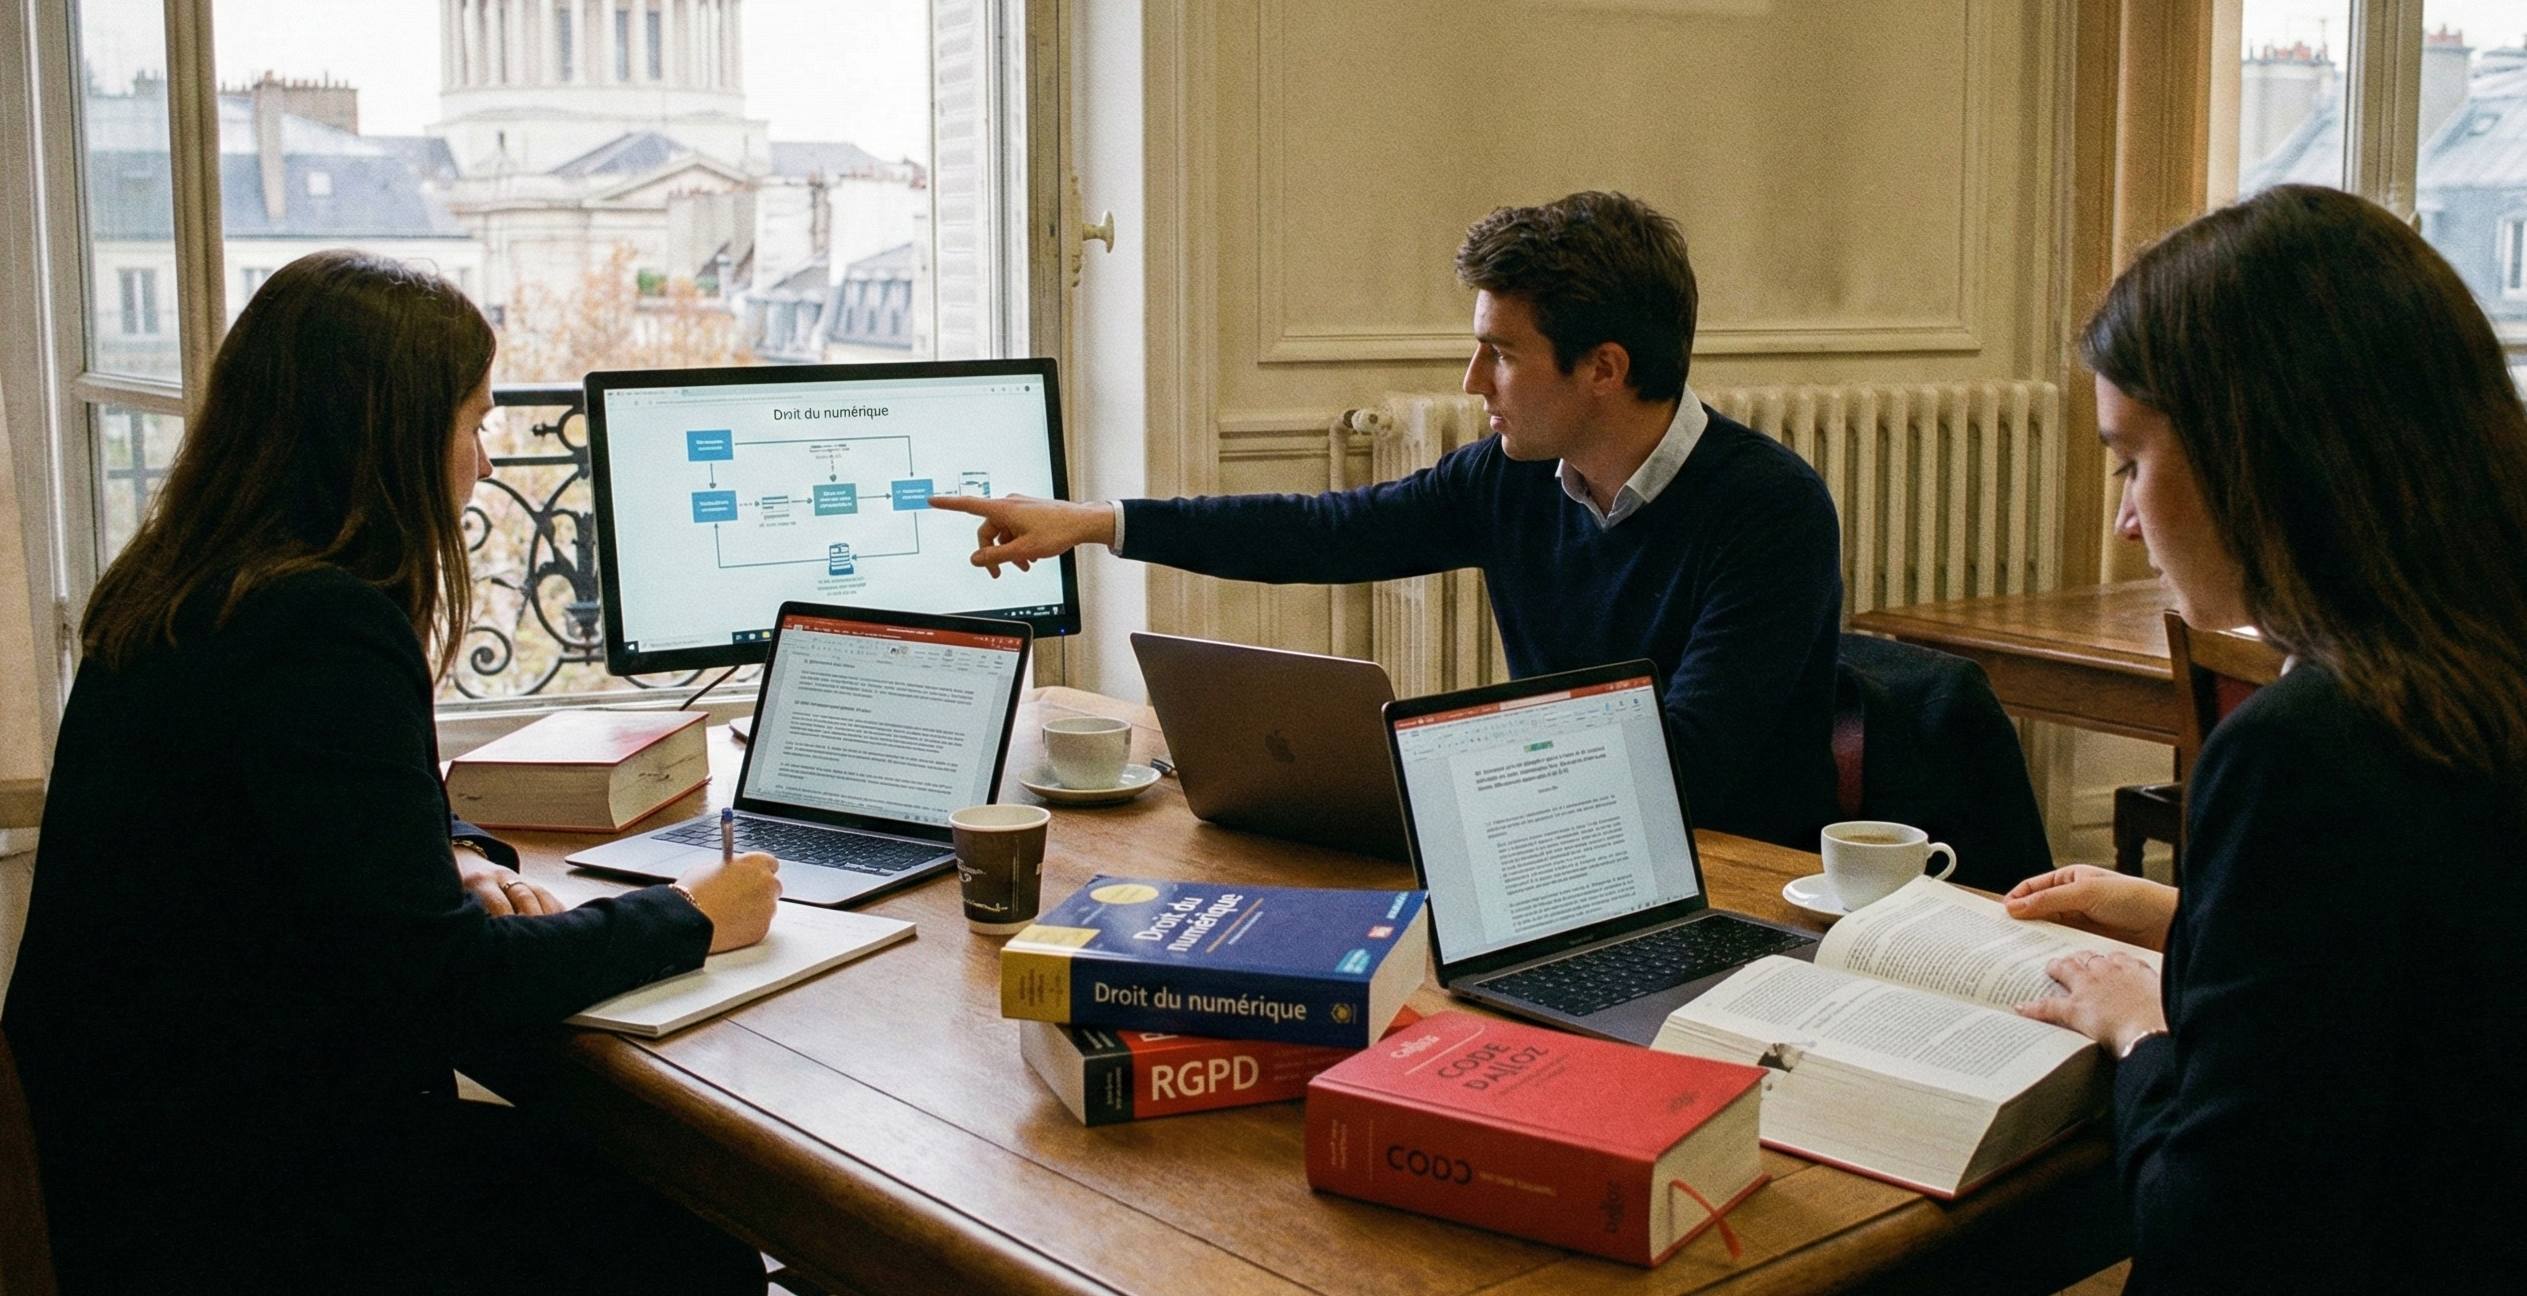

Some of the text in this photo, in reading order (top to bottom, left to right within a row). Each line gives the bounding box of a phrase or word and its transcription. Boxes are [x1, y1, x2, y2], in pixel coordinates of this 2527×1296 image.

[804, 407, 820, 420] du
[824, 405, 889, 420] numérique
[1133, 896, 1204, 941] Droit du
[1167, 893, 1244, 952] numérique
[1094, 981, 1148, 1007] Droit
[1154, 987, 1181, 1010] du
[1188, 993, 1308, 1023] numérique
[1151, 1055, 1260, 1101] RGPD
[1438, 1043, 1511, 1079] CODE
